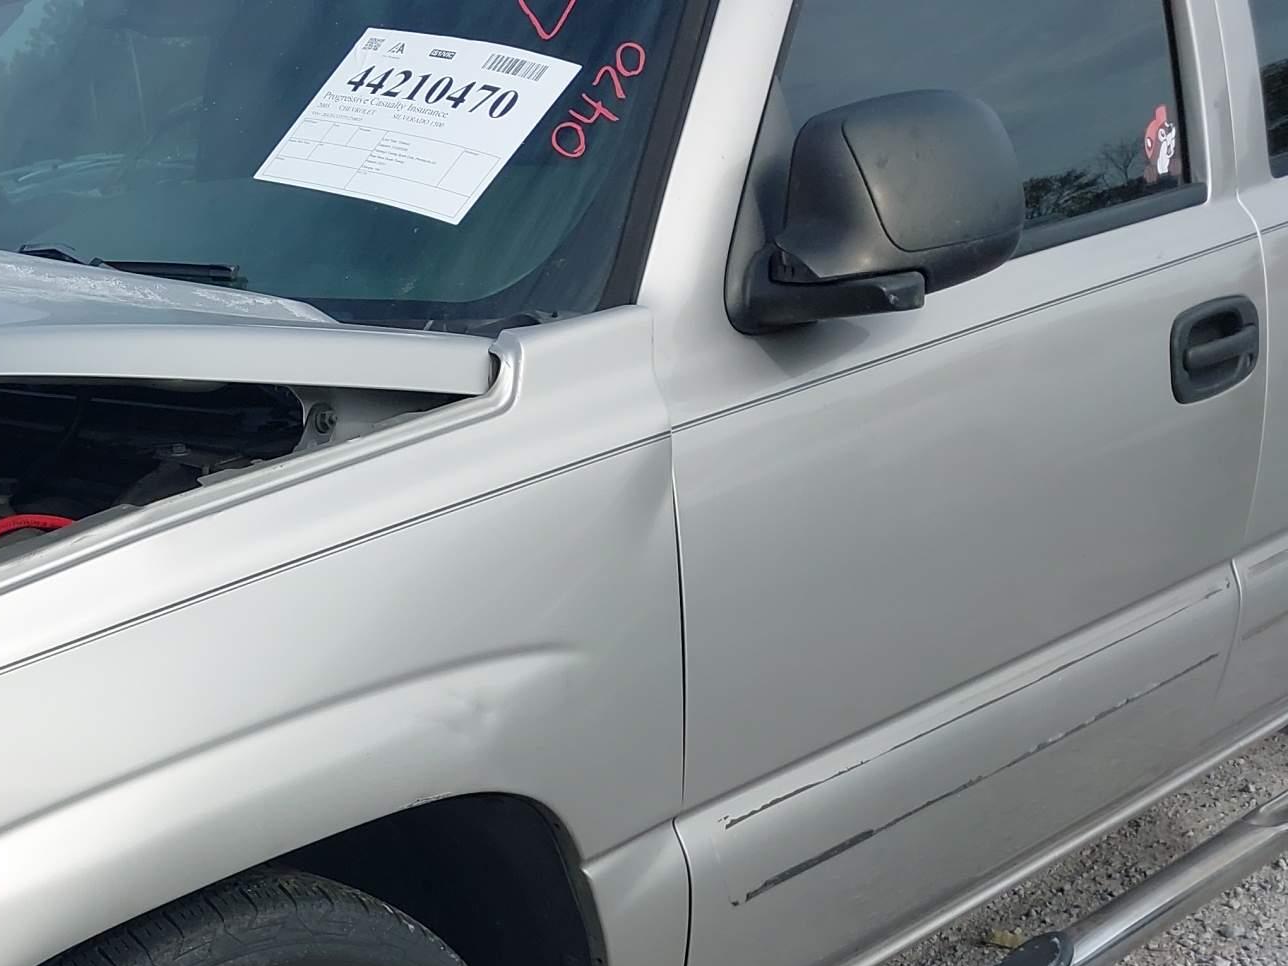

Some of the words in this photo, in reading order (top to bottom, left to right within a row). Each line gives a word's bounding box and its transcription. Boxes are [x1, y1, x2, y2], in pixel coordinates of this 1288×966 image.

[323, 91, 370, 105] Progressive
[371, 98, 404, 112] Casualty
[407, 103, 449, 119] Insurance
[347, 65, 519, 119] 44210470
[551, 42, 646, 158] 0470
[338, 104, 377, 116] CHEVROLET
[393, 113, 430, 126] SILVERADO
